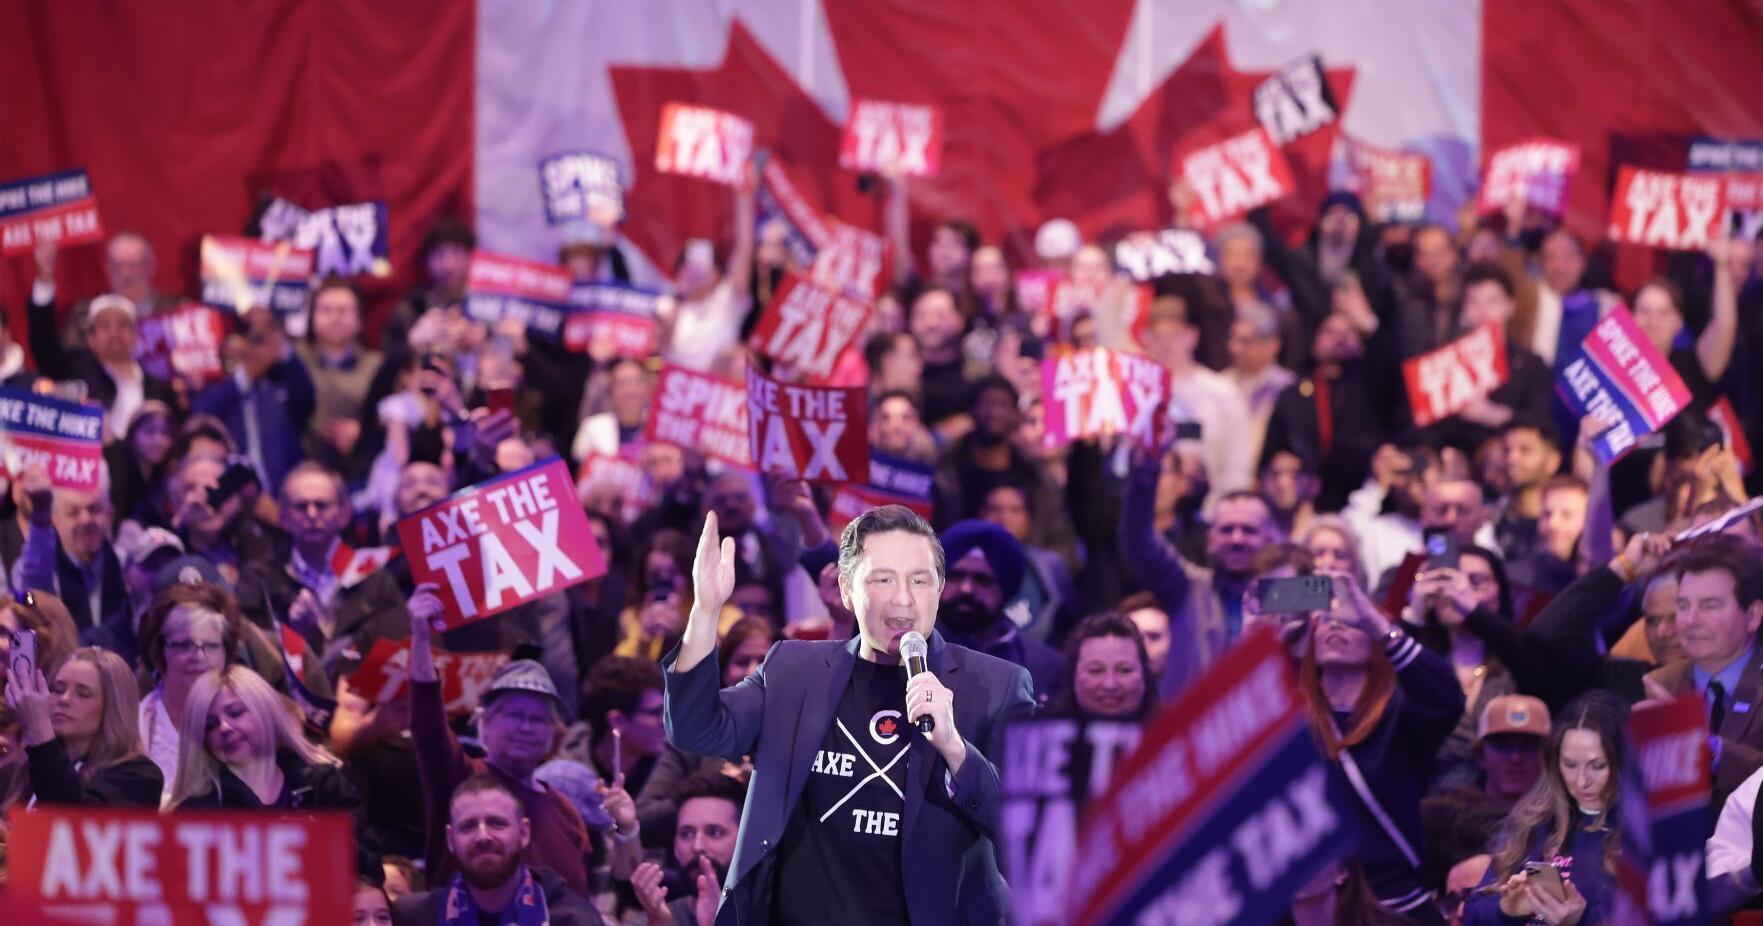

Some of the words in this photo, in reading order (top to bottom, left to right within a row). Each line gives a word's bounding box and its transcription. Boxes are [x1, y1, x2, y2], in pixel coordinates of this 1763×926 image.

[1256, 81, 1337, 146] TAX
[672, 122, 750, 184] TAX
[853, 122, 929, 175] TAX
[1184, 153, 1283, 221] TAX
[1628, 168, 1674, 199] AXE
[1680, 174, 1719, 203] THE
[1626, 192, 1718, 250] TAX
[766, 302, 860, 380] TAX
[1056, 350, 1107, 385] AXE
[1116, 351, 1165, 386] THE
[1595, 316, 1640, 368] SPIKE
[1627, 355, 1661, 396] THE
[659, 369, 748, 427] SPIK
[785, 386, 848, 421] THE
[1420, 352, 1501, 420] TAX
[1562, 358, 1599, 403] AXE
[27, 402, 59, 432] THE
[58, 411, 100, 440] HIKE
[749, 398, 849, 481] TAX
[1053, 376, 1164, 446] TAX
[54, 453, 97, 483] TAX
[421, 499, 488, 554] AXE
[486, 473, 557, 525] THE
[425, 508, 583, 619] TAX
[376, 664, 492, 711] TX
[811, 749, 856, 778] AXE
[852, 808, 900, 837] THE
[1232, 762, 1340, 890] TAX
[41, 819, 163, 899] AXE
[176, 822, 309, 902] THE
